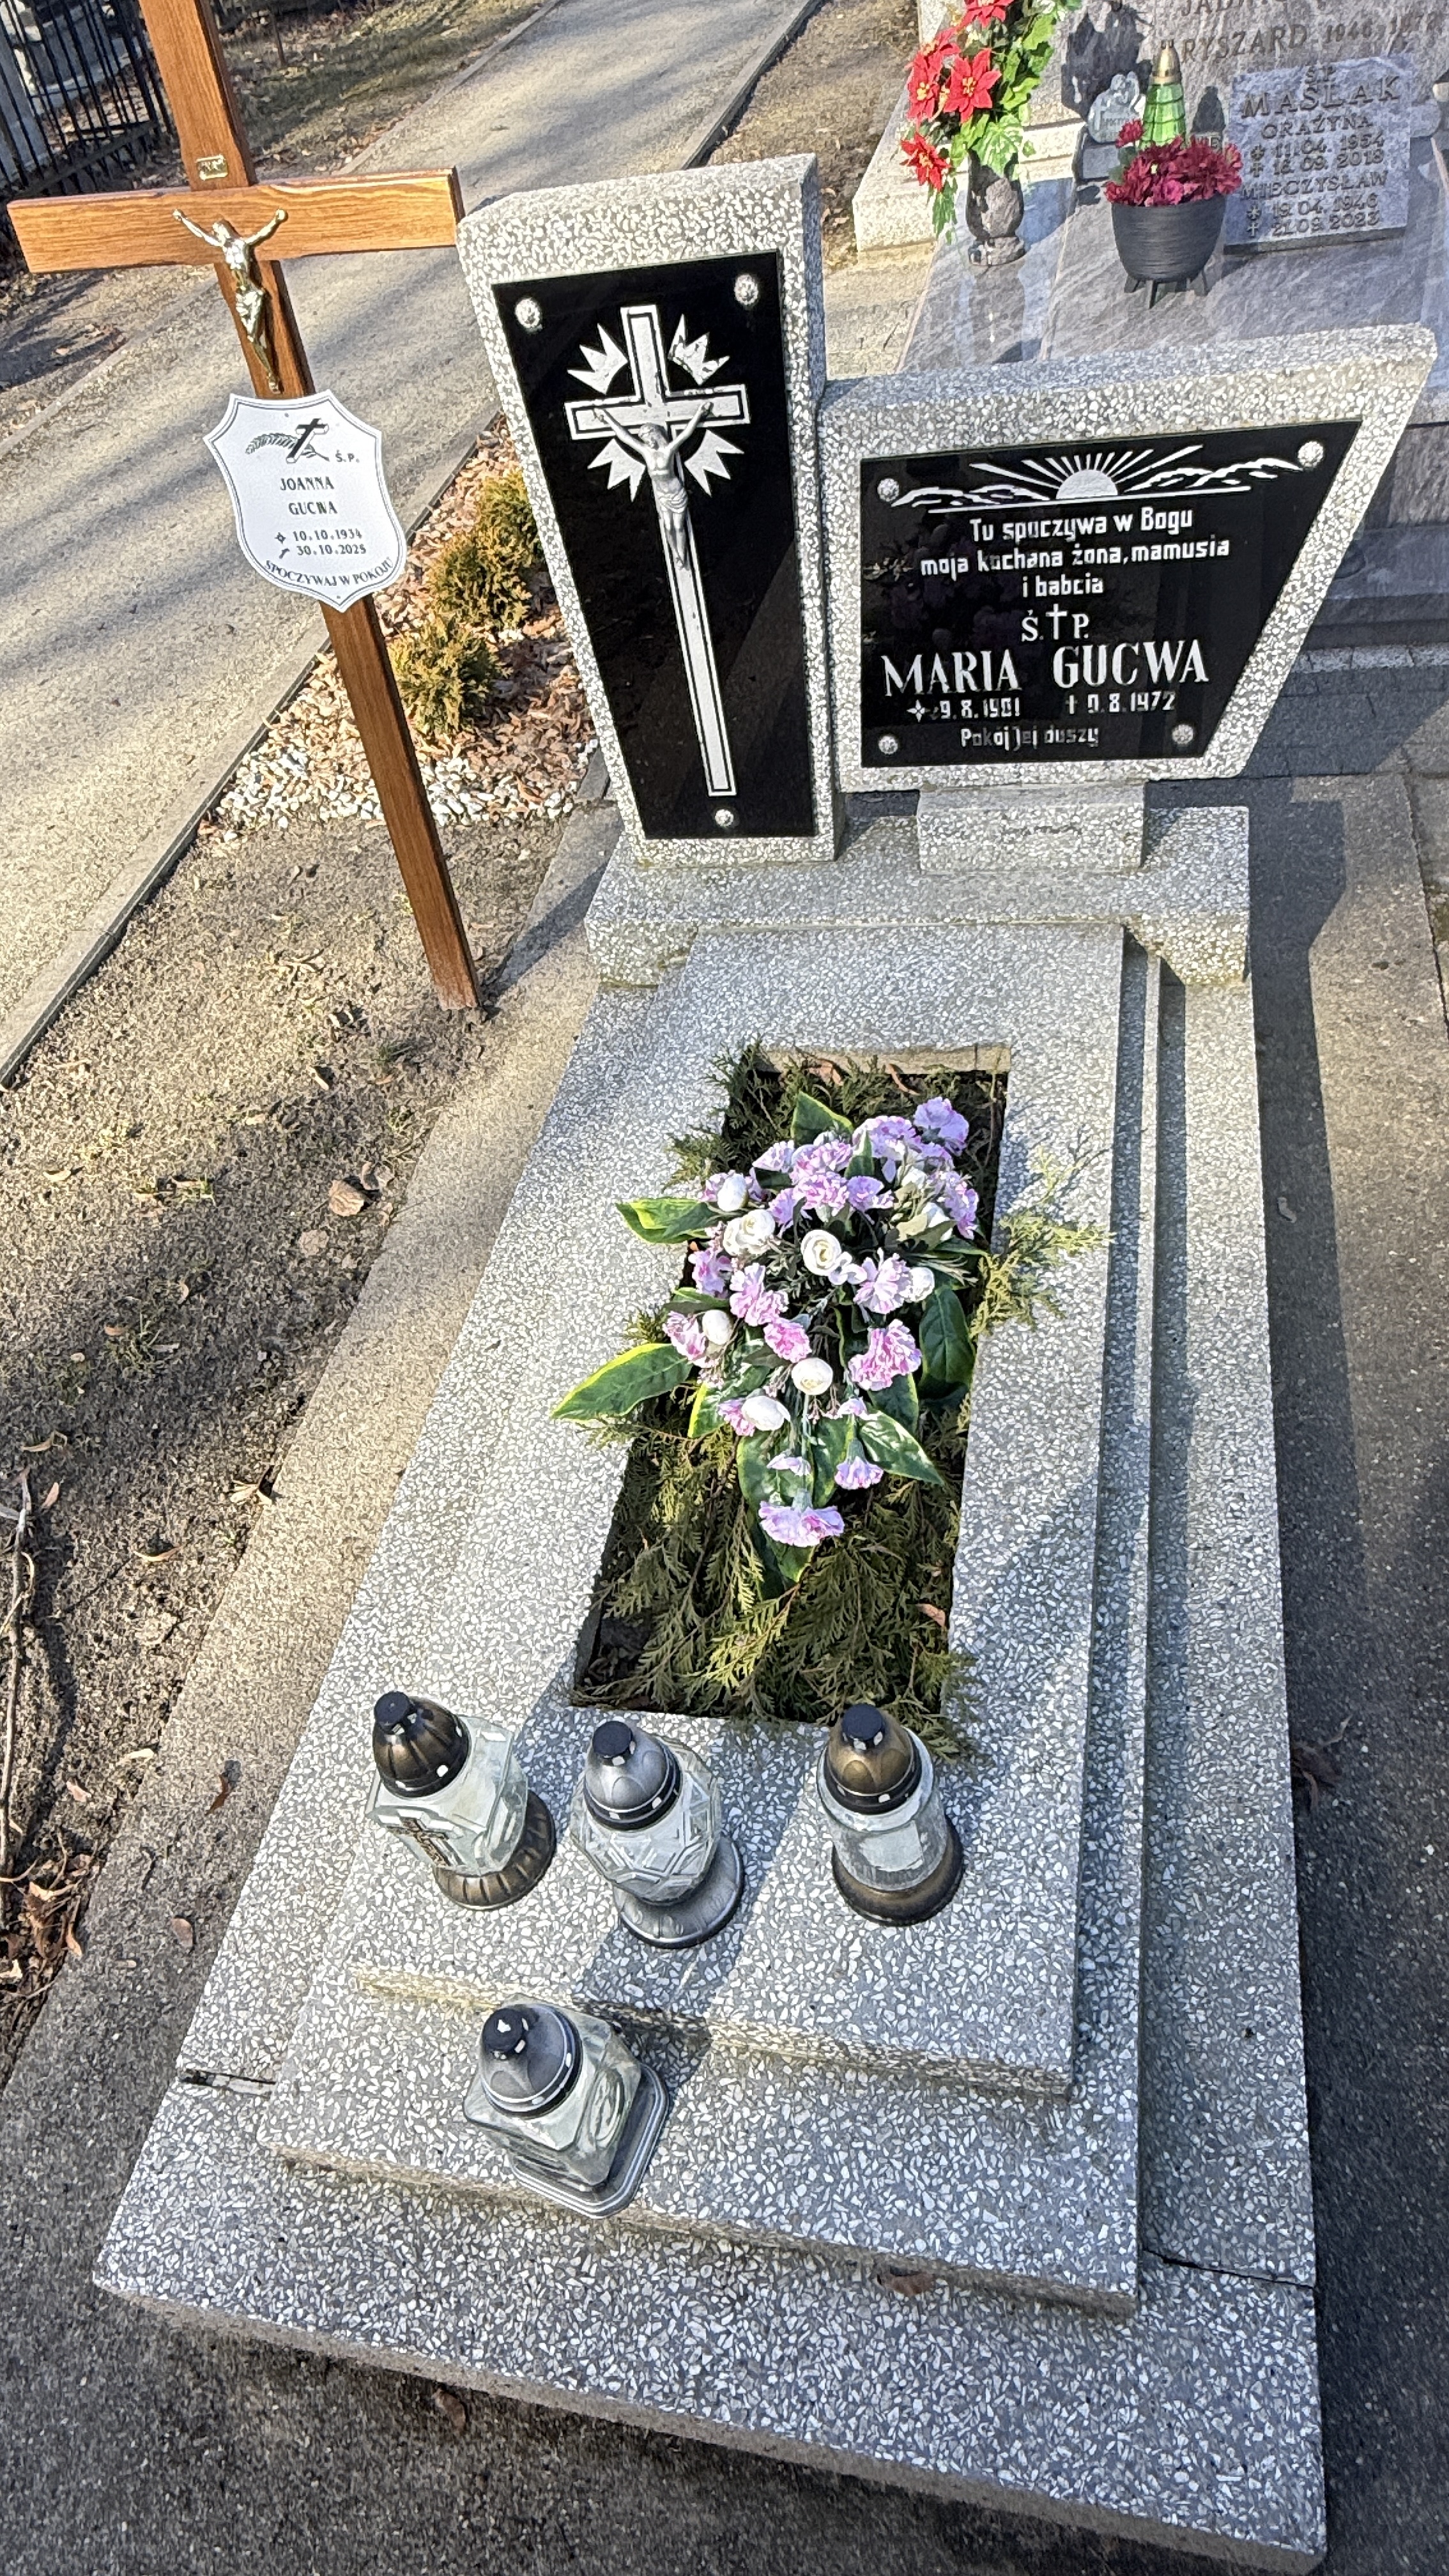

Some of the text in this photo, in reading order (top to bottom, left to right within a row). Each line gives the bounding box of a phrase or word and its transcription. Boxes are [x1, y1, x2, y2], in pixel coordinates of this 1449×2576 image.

[1181, 24, 1307, 63] RYSZARD
[280, 476, 334, 491] JOANNA
[288, 501, 337, 515] GUCWA
[293, 528, 362, 541] 10.10.1934
[969, 518, 993, 542] Tu
[1112, 514, 1133, 532] w
[1140, 507, 1193, 536] Bogu
[296, 543, 366, 556] 30.10.2025
[920, 556, 969, 582] moja
[977, 546, 1063, 572] kochana
[1131, 535, 1230, 562] mamusia
[264, 556, 394, 586] SPOCZYWAJ W POKOJU
[1022, 572, 1103, 598] i babcia
[881, 639, 1209, 696] MARIA GUCWA
[1043, 726, 1100, 749] duszy
